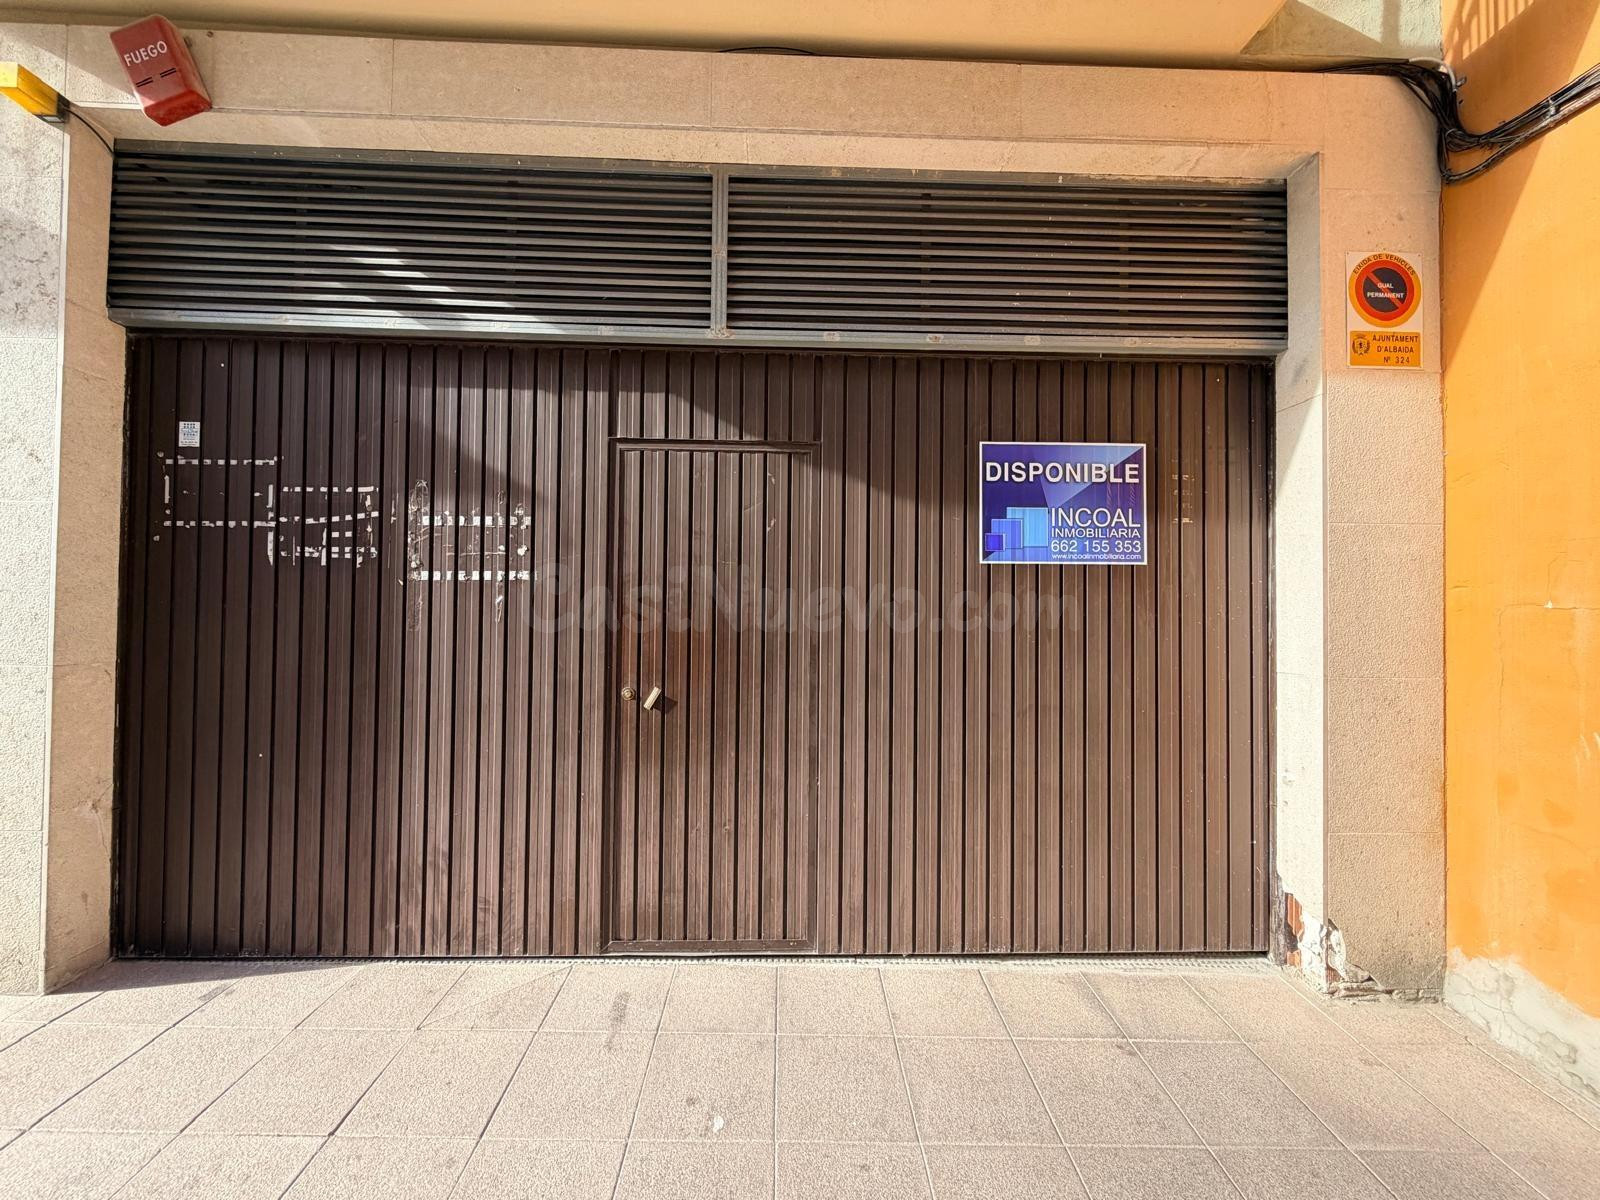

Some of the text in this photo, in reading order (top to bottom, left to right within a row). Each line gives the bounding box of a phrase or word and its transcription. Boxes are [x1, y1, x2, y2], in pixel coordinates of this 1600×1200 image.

[124, 41, 167, 66] FUEGO
[1353, 256, 1372, 275] EIXIDA
[1385, 254, 1416, 276] VEHICLES
[1372, 335, 1418, 343] AJUNTAMENT
[985, 462, 1140, 483] DISPONIBLE
[1051, 508, 1140, 527] INCOAL
[1051, 528, 1140, 538] INMOBILIARIA
[1051, 540, 1141, 552] 662 155 353
